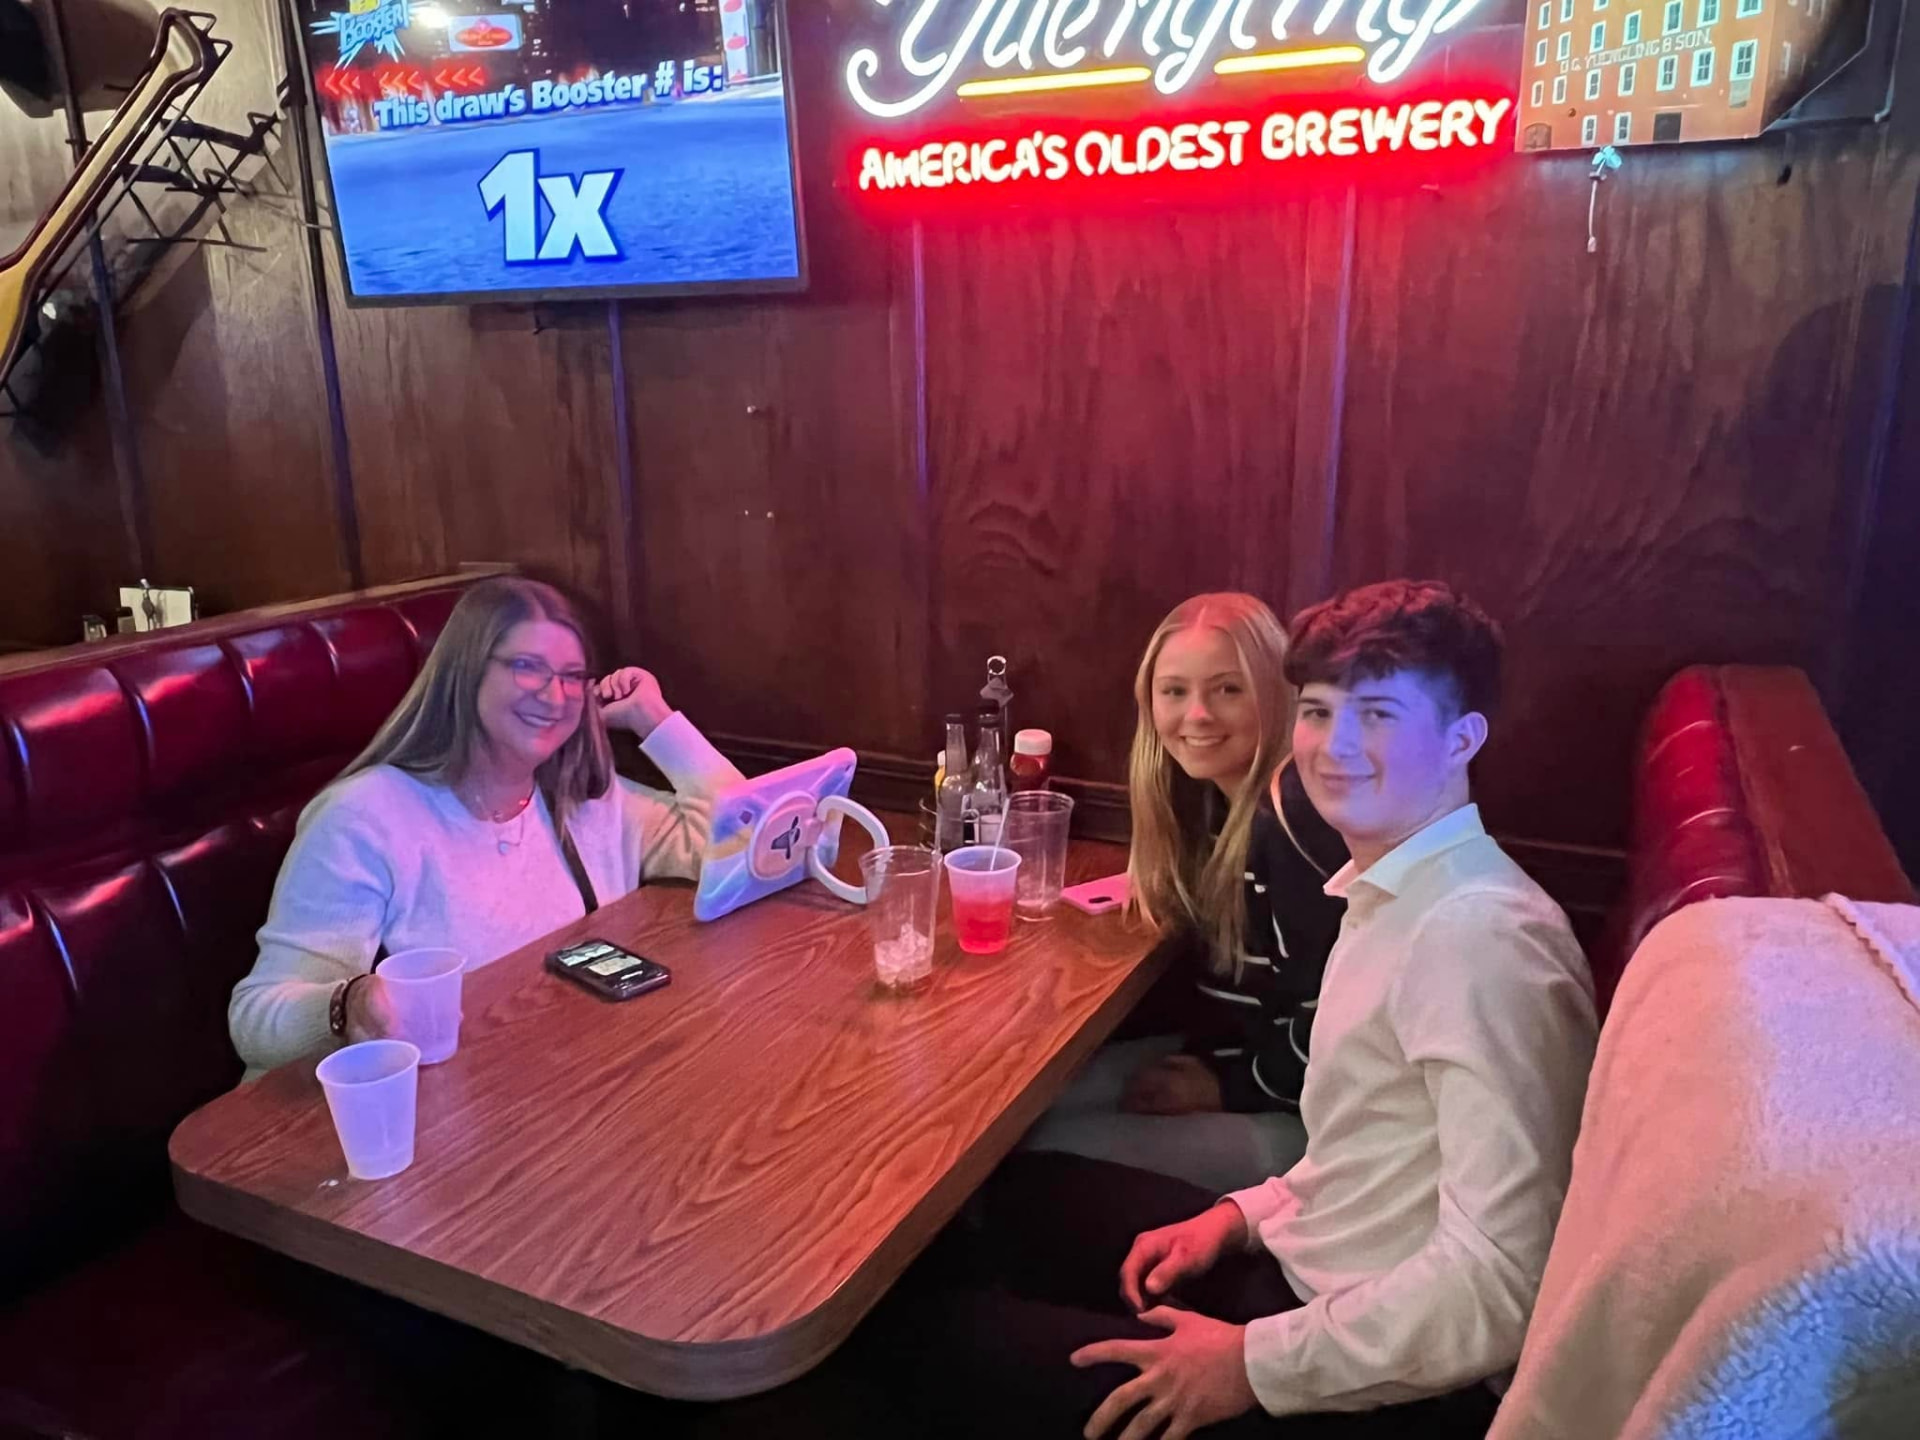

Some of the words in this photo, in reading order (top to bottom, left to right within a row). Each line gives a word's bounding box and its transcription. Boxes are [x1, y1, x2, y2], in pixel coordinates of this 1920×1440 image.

[374, 101, 429, 129] This
[436, 84, 526, 122] draw's
[533, 75, 648, 110] Booster
[655, 60, 676, 95] #
[683, 61, 723, 92] is:
[858, 130, 1069, 191] AMERICA'S
[1073, 119, 1252, 177] OLDEST
[1260, 98, 1512, 162] BREWERY
[479, 149, 624, 265] 1x
